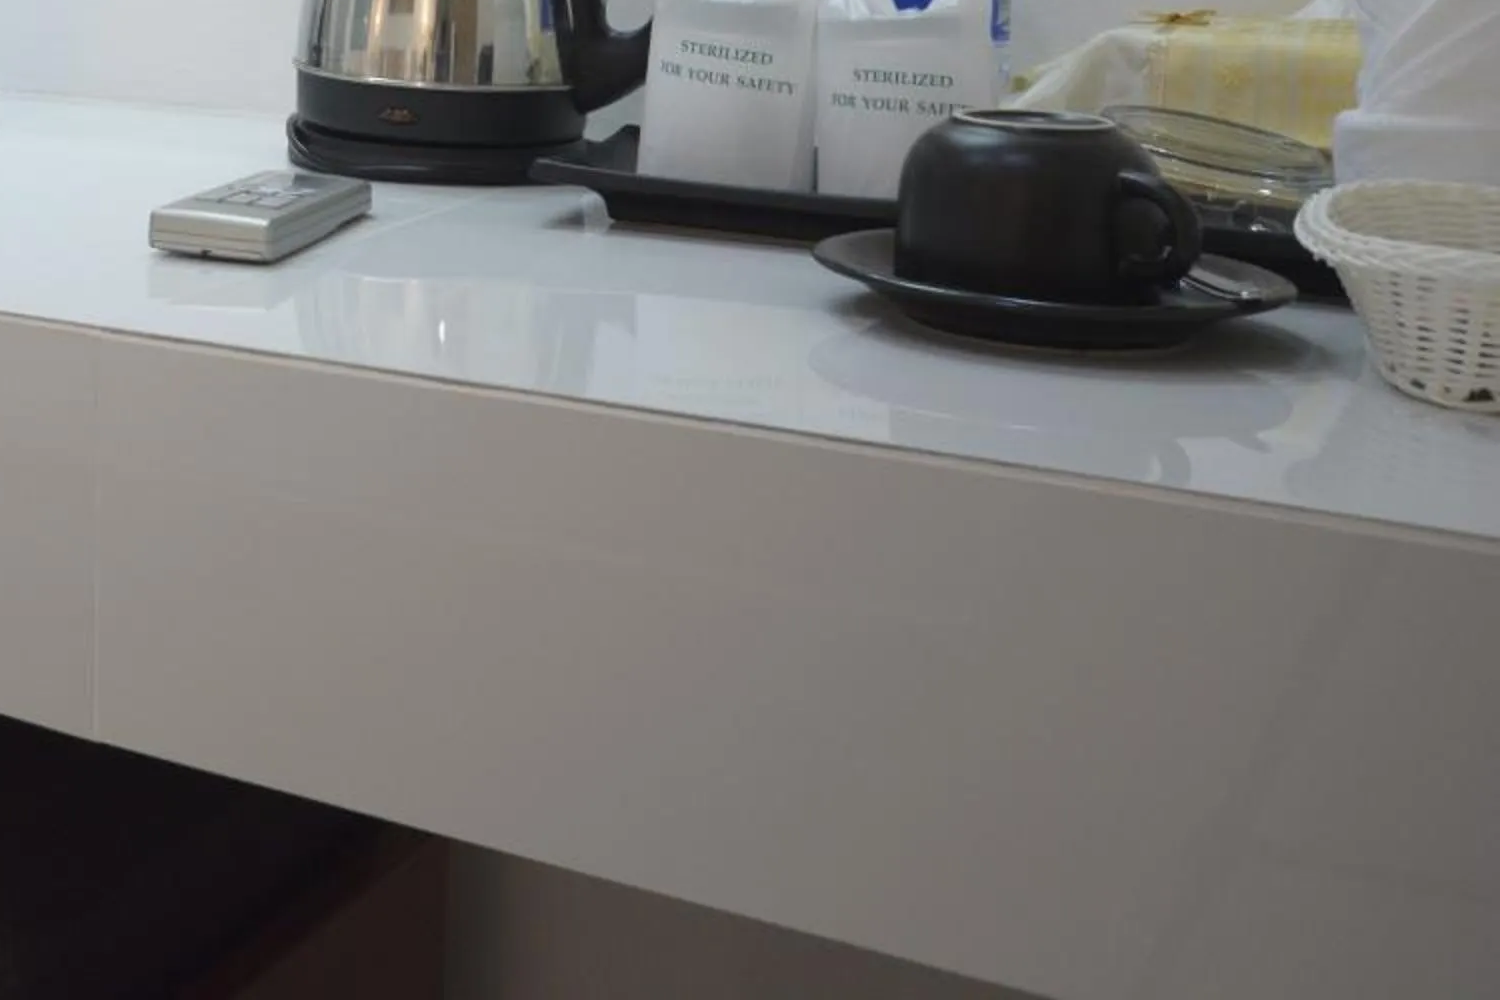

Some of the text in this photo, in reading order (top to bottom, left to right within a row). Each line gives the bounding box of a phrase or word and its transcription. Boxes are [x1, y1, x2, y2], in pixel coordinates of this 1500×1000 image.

[680, 39, 774, 66] STERILIZED
[687, 66, 730, 88] YOUR
[737, 74, 798, 97] SAFETY
[853, 67, 954, 88] STERILIZED
[861, 95, 910, 114] YOUR
